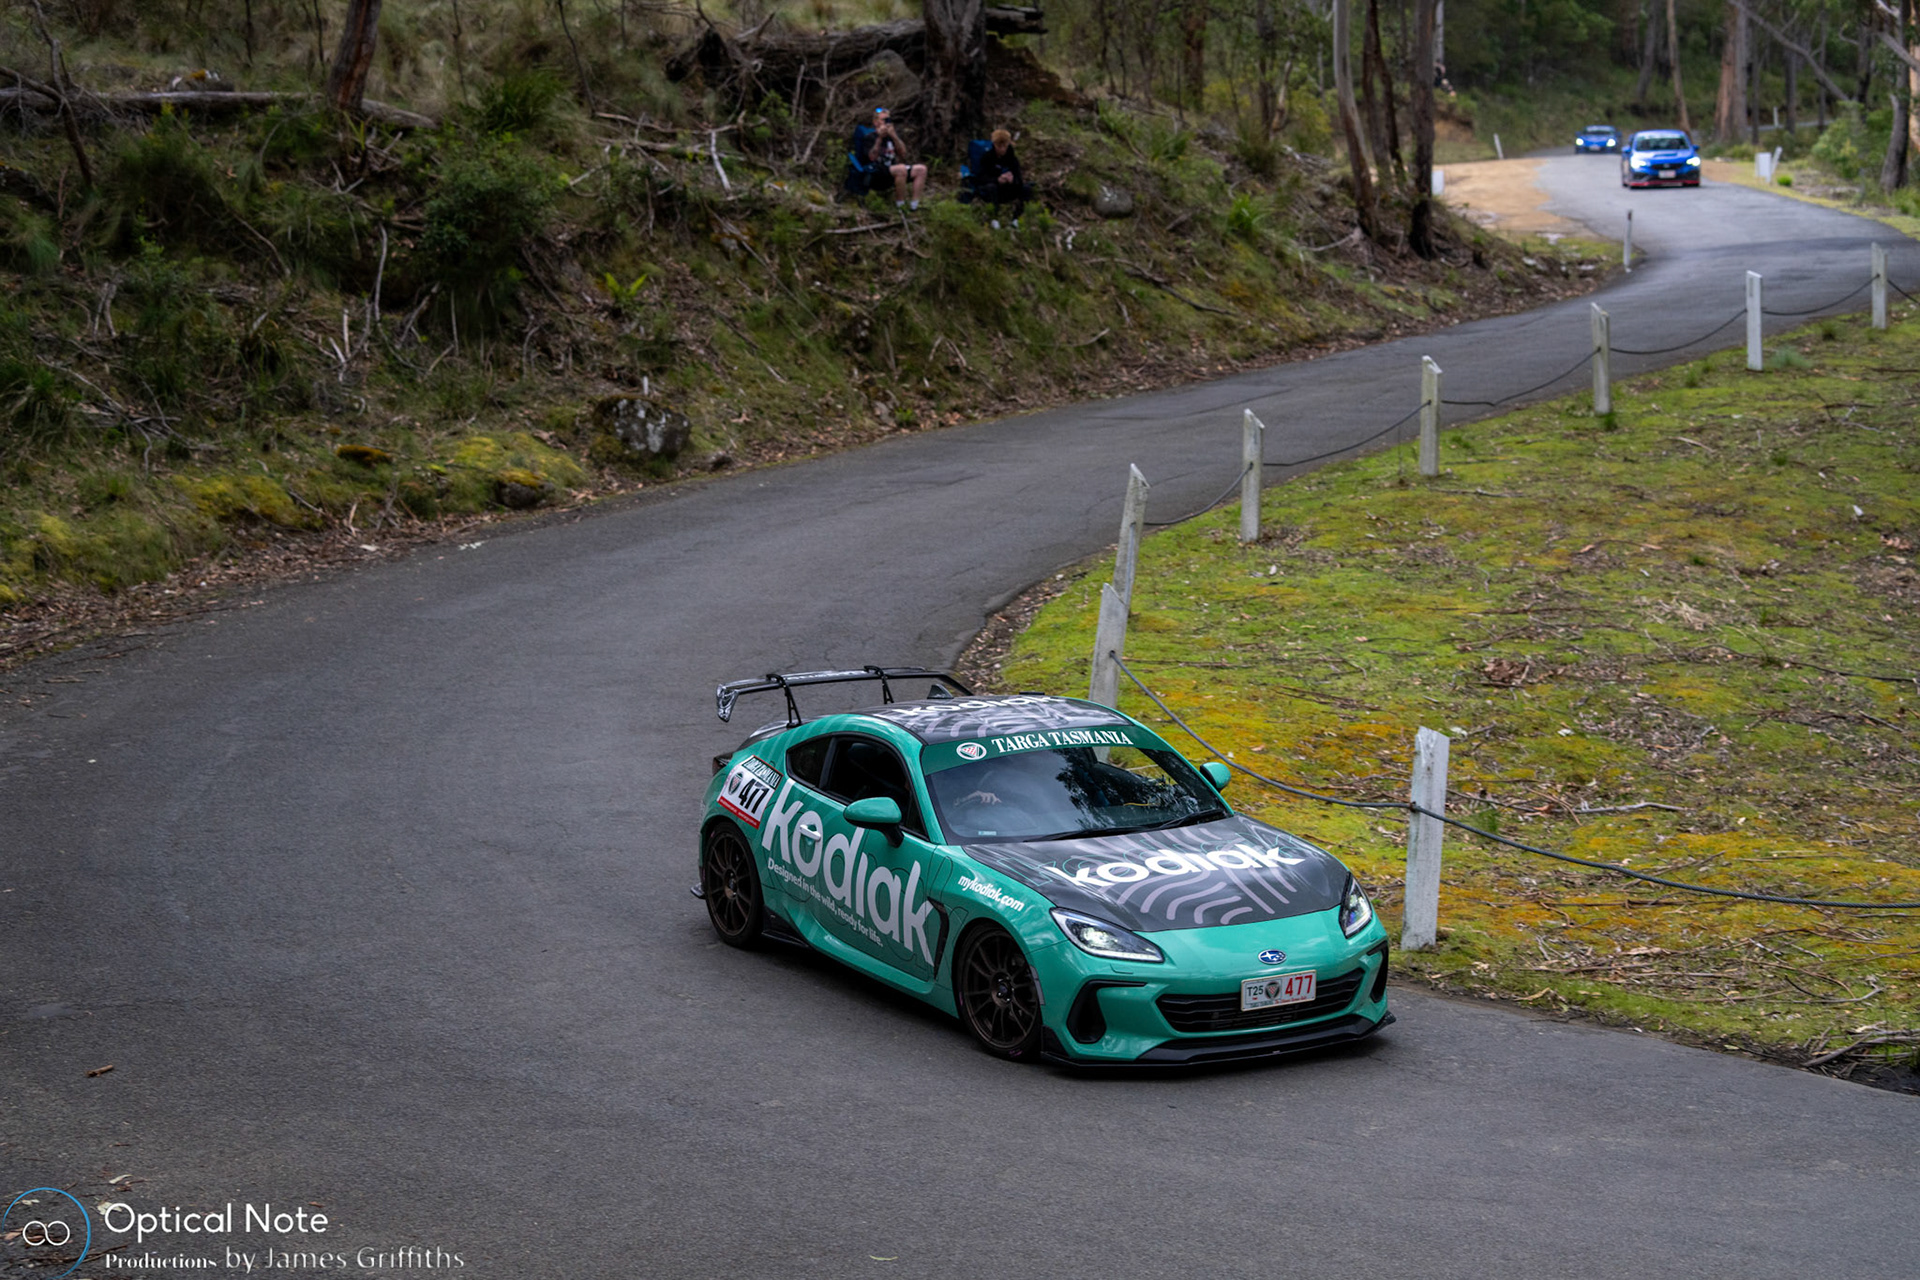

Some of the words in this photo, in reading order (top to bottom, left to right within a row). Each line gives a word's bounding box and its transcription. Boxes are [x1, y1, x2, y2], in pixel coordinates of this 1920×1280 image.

[991, 732, 1051, 753] TARGA
[1047, 730, 1134, 746] TASMANIA
[738, 778, 770, 814] 477
[761, 778, 934, 967] kodiak
[1043, 842, 1305, 887] kodiak
[767, 857, 802, 887] Designed
[802, 878, 810, 892] in
[809, 884, 822, 902] the
[821, 896, 838, 915] wild,
[837, 907, 858, 931] ready
[857, 919, 869, 936] for
[868, 926, 884, 947] life.
[957, 875, 1025, 912] mykodiak.com
[1247, 985, 1264, 997] T25
[1285, 974, 1313, 996] 477
